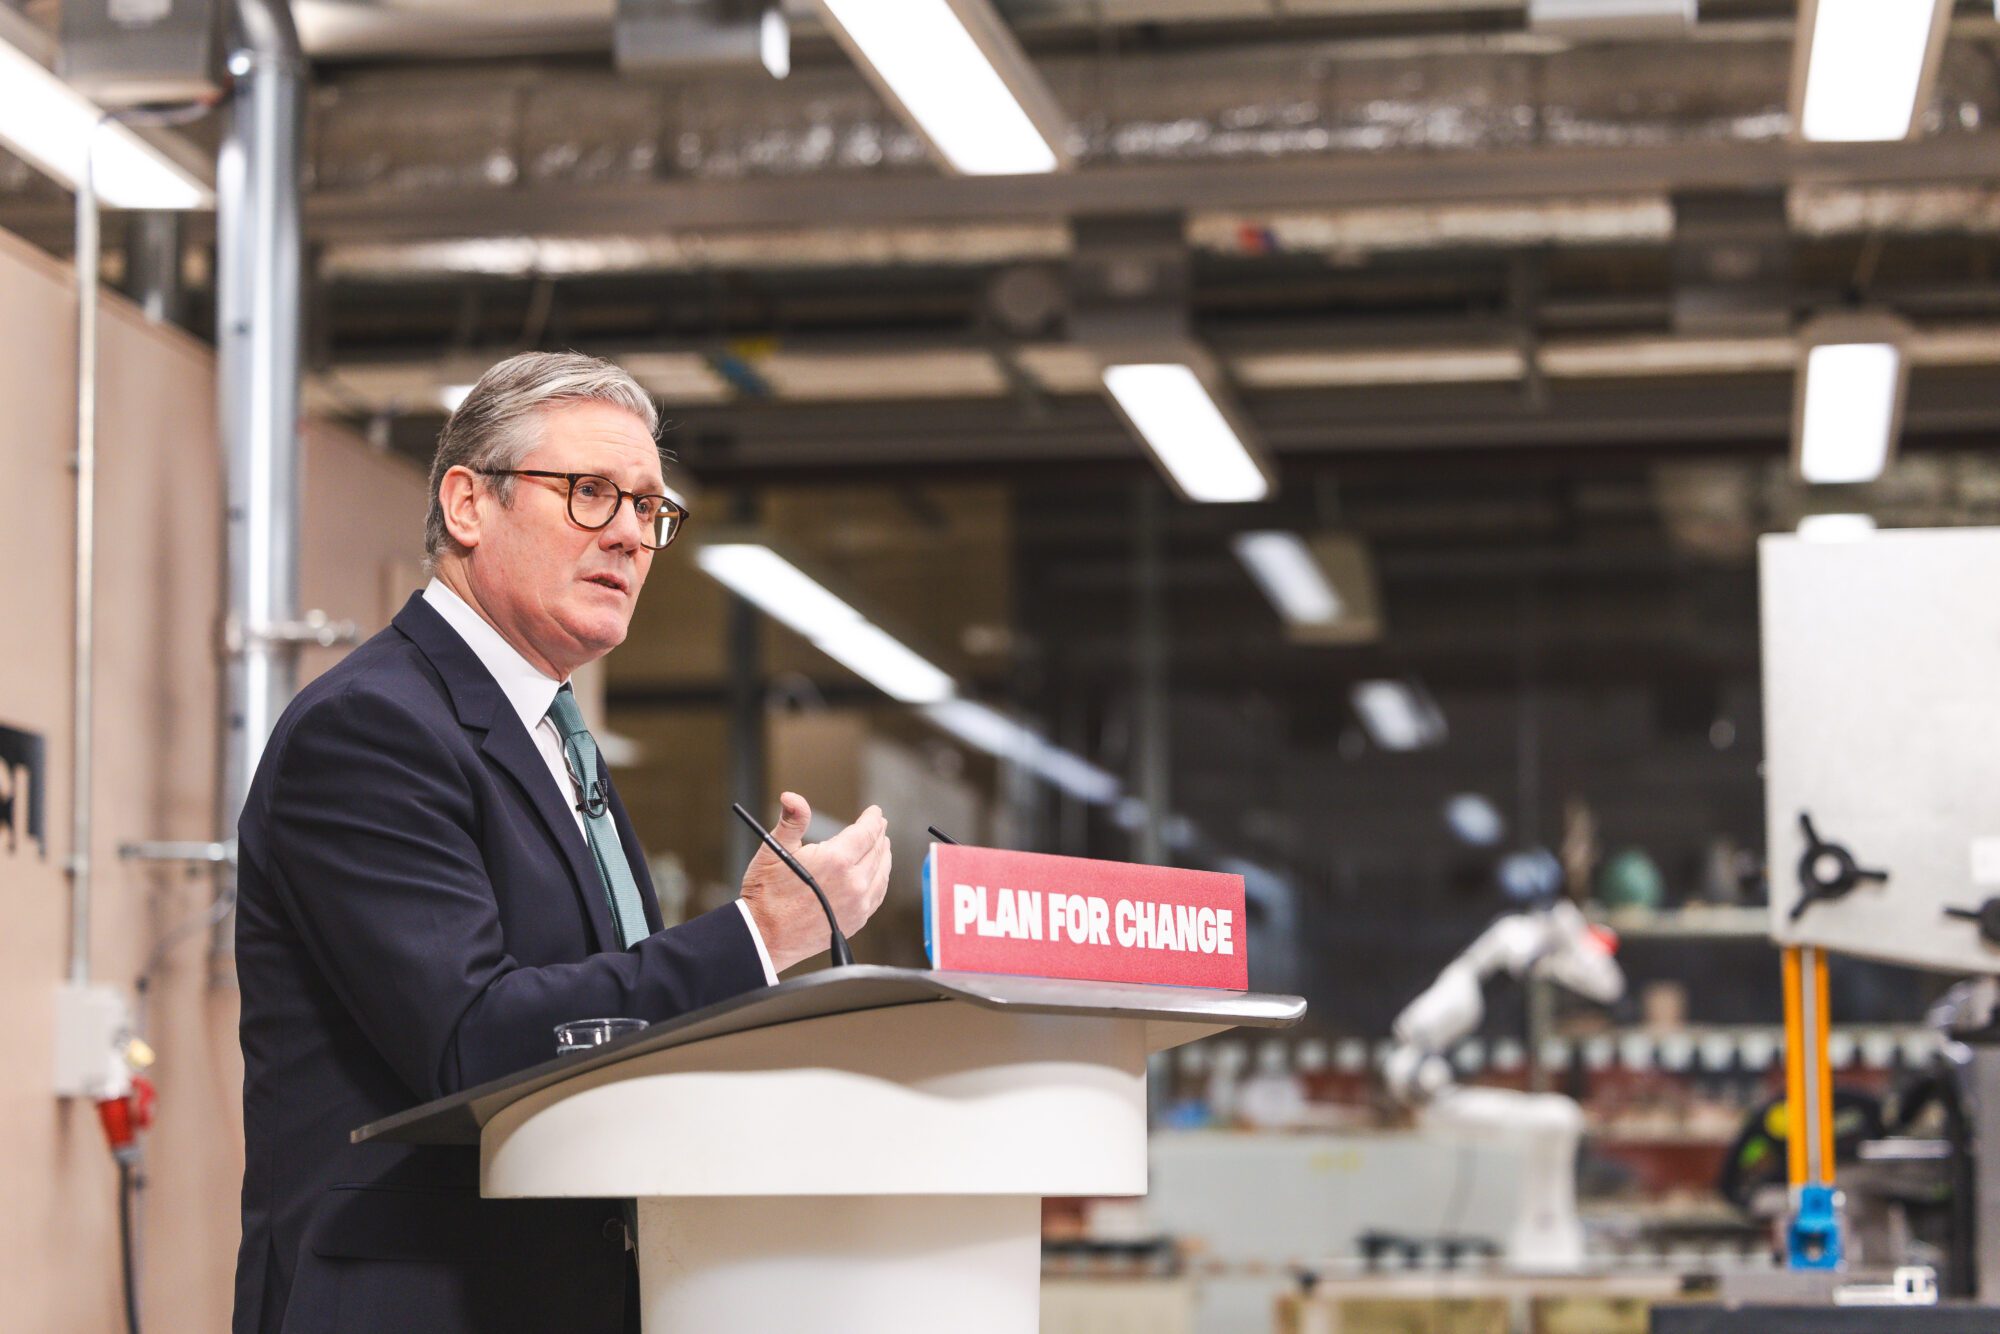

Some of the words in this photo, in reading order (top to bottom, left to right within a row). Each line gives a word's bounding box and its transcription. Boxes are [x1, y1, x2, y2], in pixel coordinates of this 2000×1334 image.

[954, 884, 1042, 941] PLAN
[1049, 892, 1111, 946] FOR
[1115, 899, 1234, 955] CHANGE
